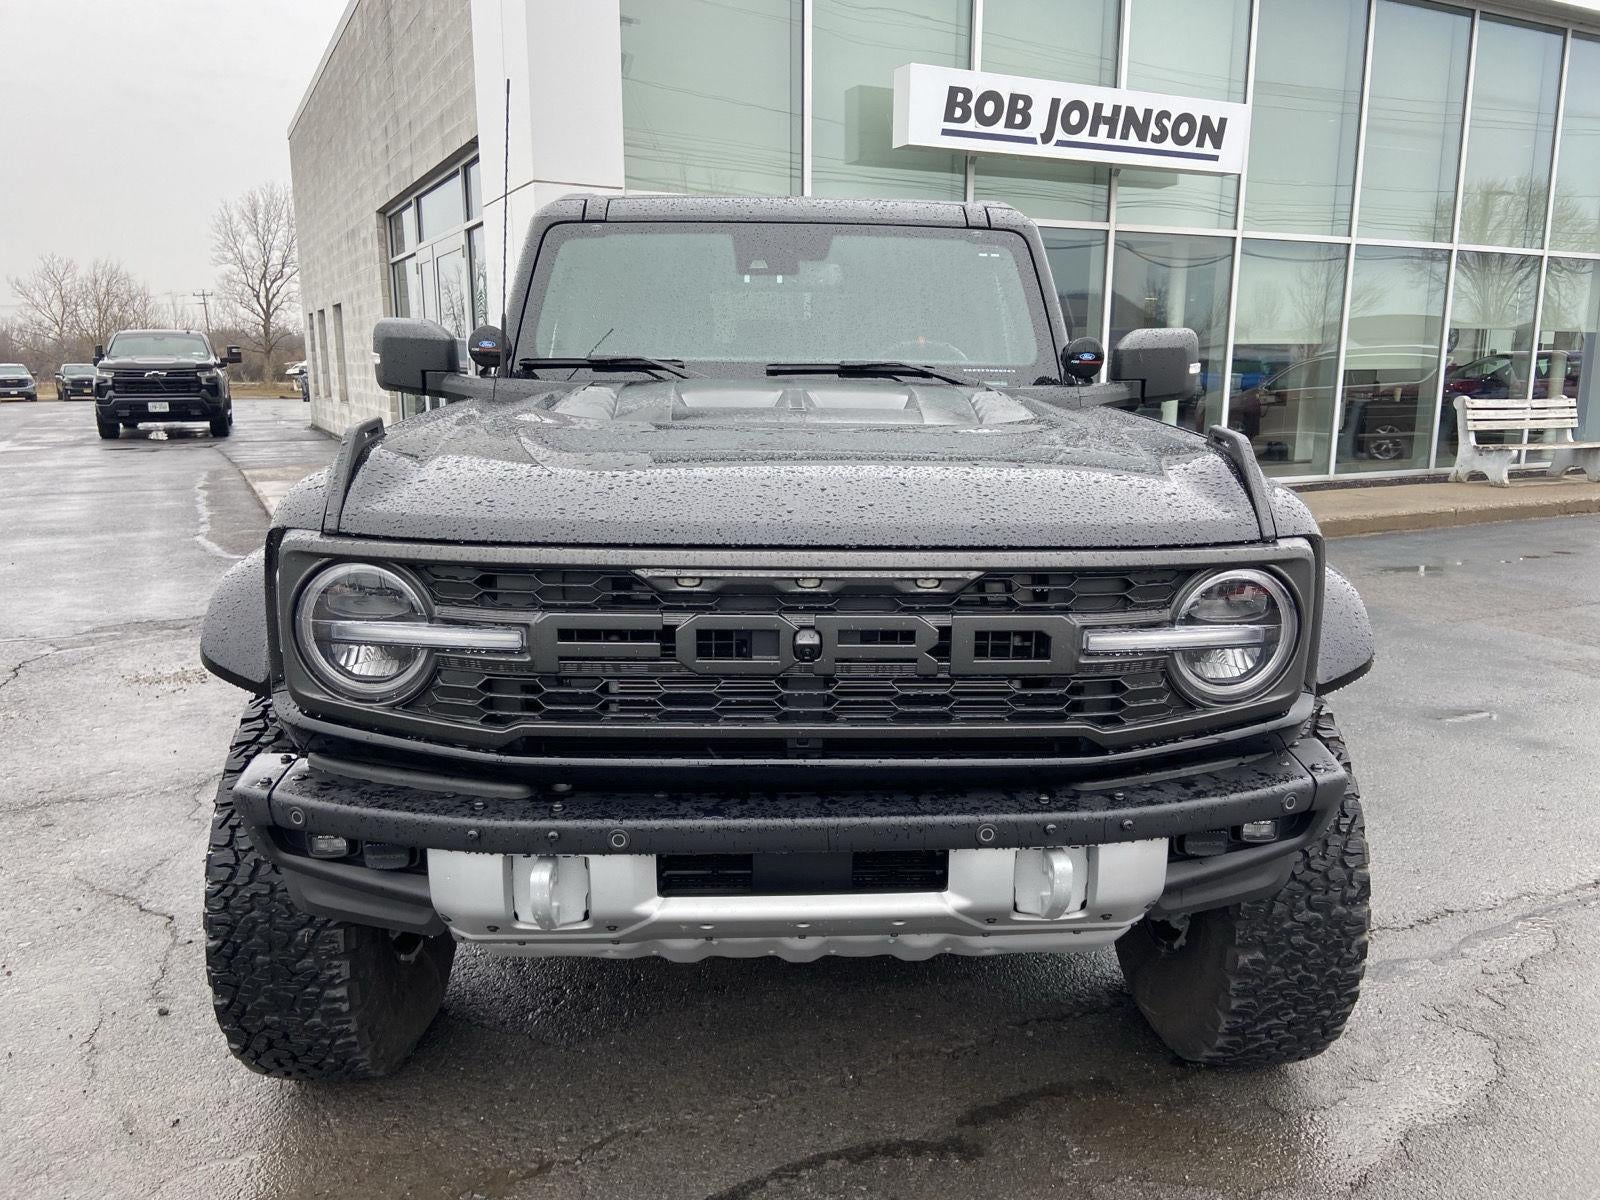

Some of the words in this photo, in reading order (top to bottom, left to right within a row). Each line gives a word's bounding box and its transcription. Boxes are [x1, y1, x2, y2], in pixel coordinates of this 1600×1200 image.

[943, 86, 1032, 130] BOB
[1040, 97, 1228, 149] JOHNSON
[534, 613, 1080, 677] FORD
